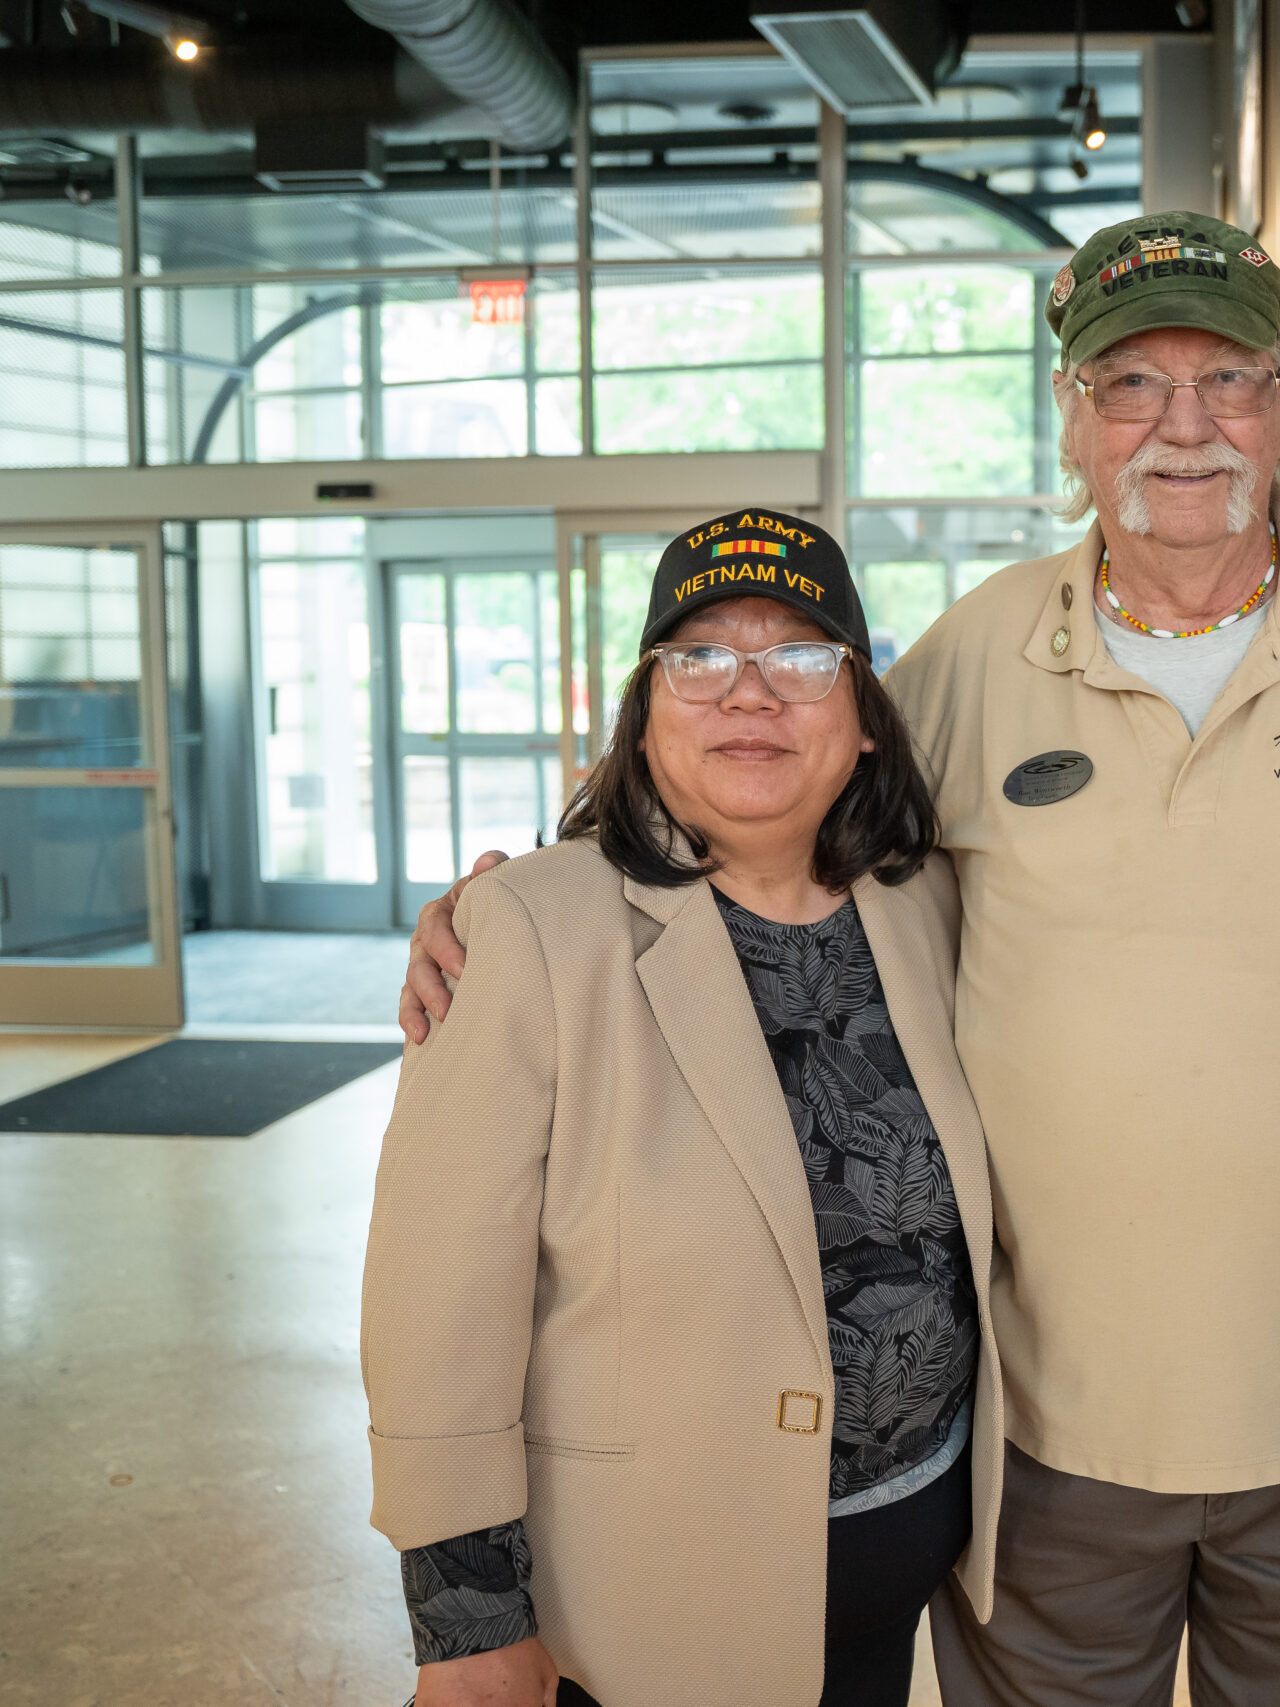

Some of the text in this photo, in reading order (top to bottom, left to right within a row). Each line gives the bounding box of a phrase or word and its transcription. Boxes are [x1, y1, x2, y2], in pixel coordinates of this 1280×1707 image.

[1102, 259, 1228, 297] VETERAN
[686, 513, 817, 549] U.S. ARMY
[674, 563, 826, 603] VIETNAM VET
